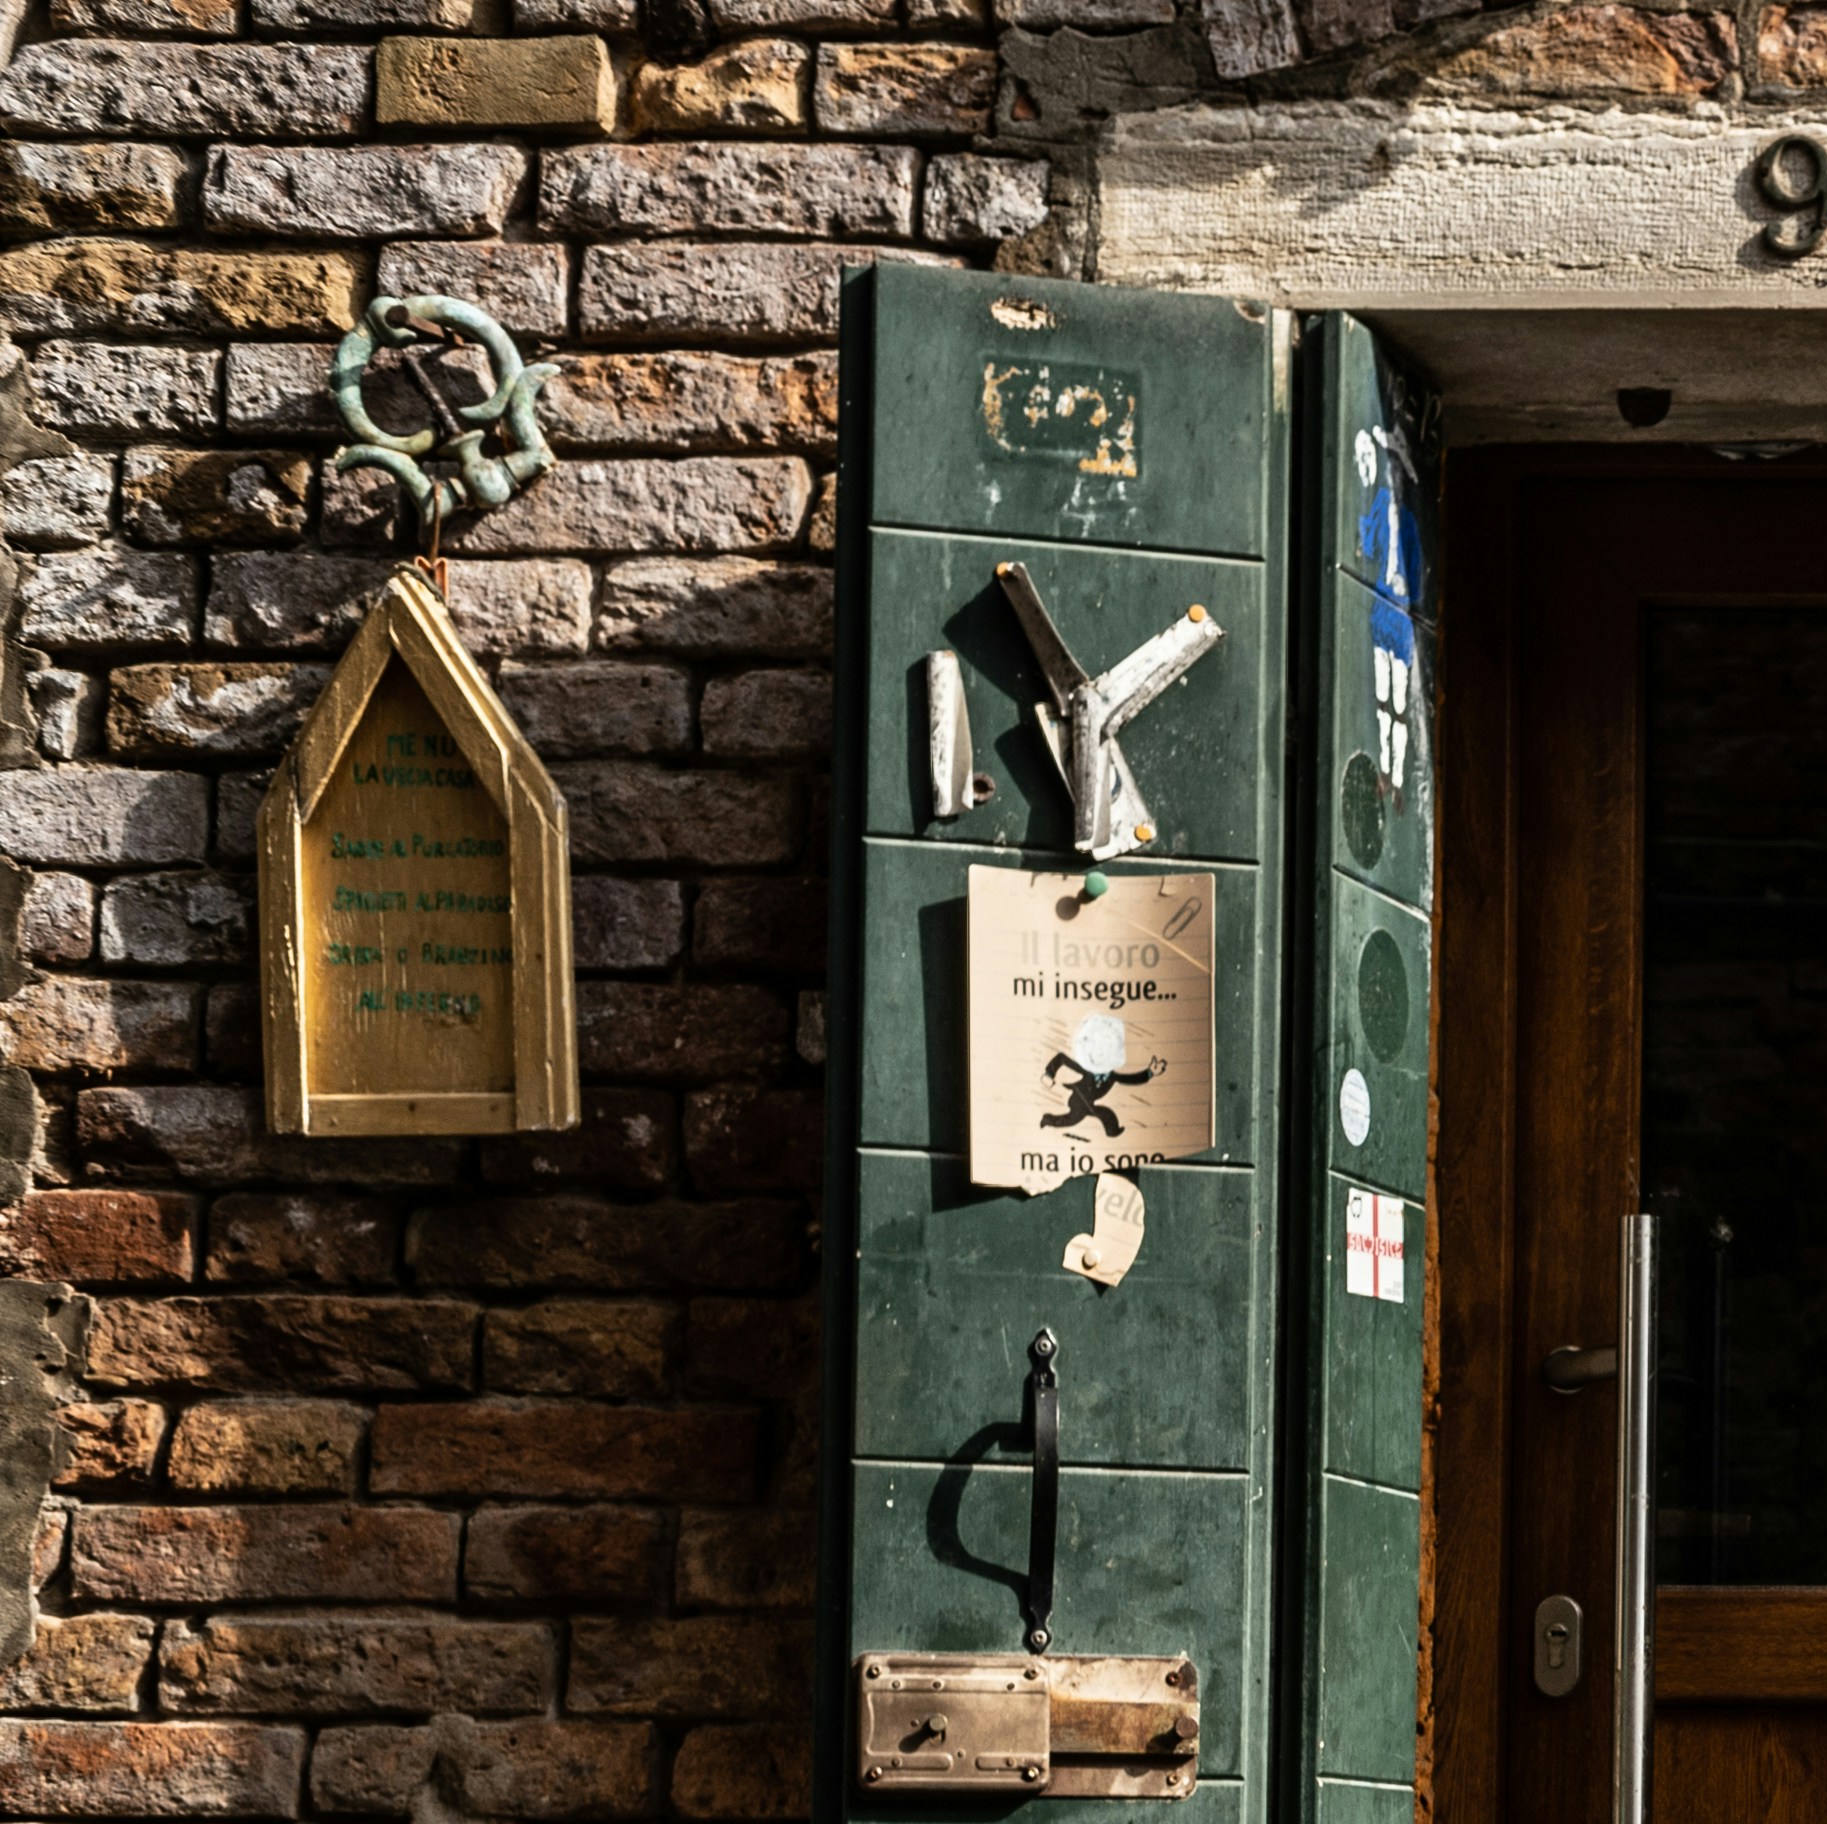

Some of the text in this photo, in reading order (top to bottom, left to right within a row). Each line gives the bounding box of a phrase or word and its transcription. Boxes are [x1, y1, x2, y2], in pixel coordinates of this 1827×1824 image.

[353, 763, 379, 785] LA
[1022, 929, 1160, 969] Il lavoro
[1013, 970, 1178, 1010] mi insegue...
[1020, 1152, 1060, 1172] ma
[1070, 1146, 1094, 1173] io
